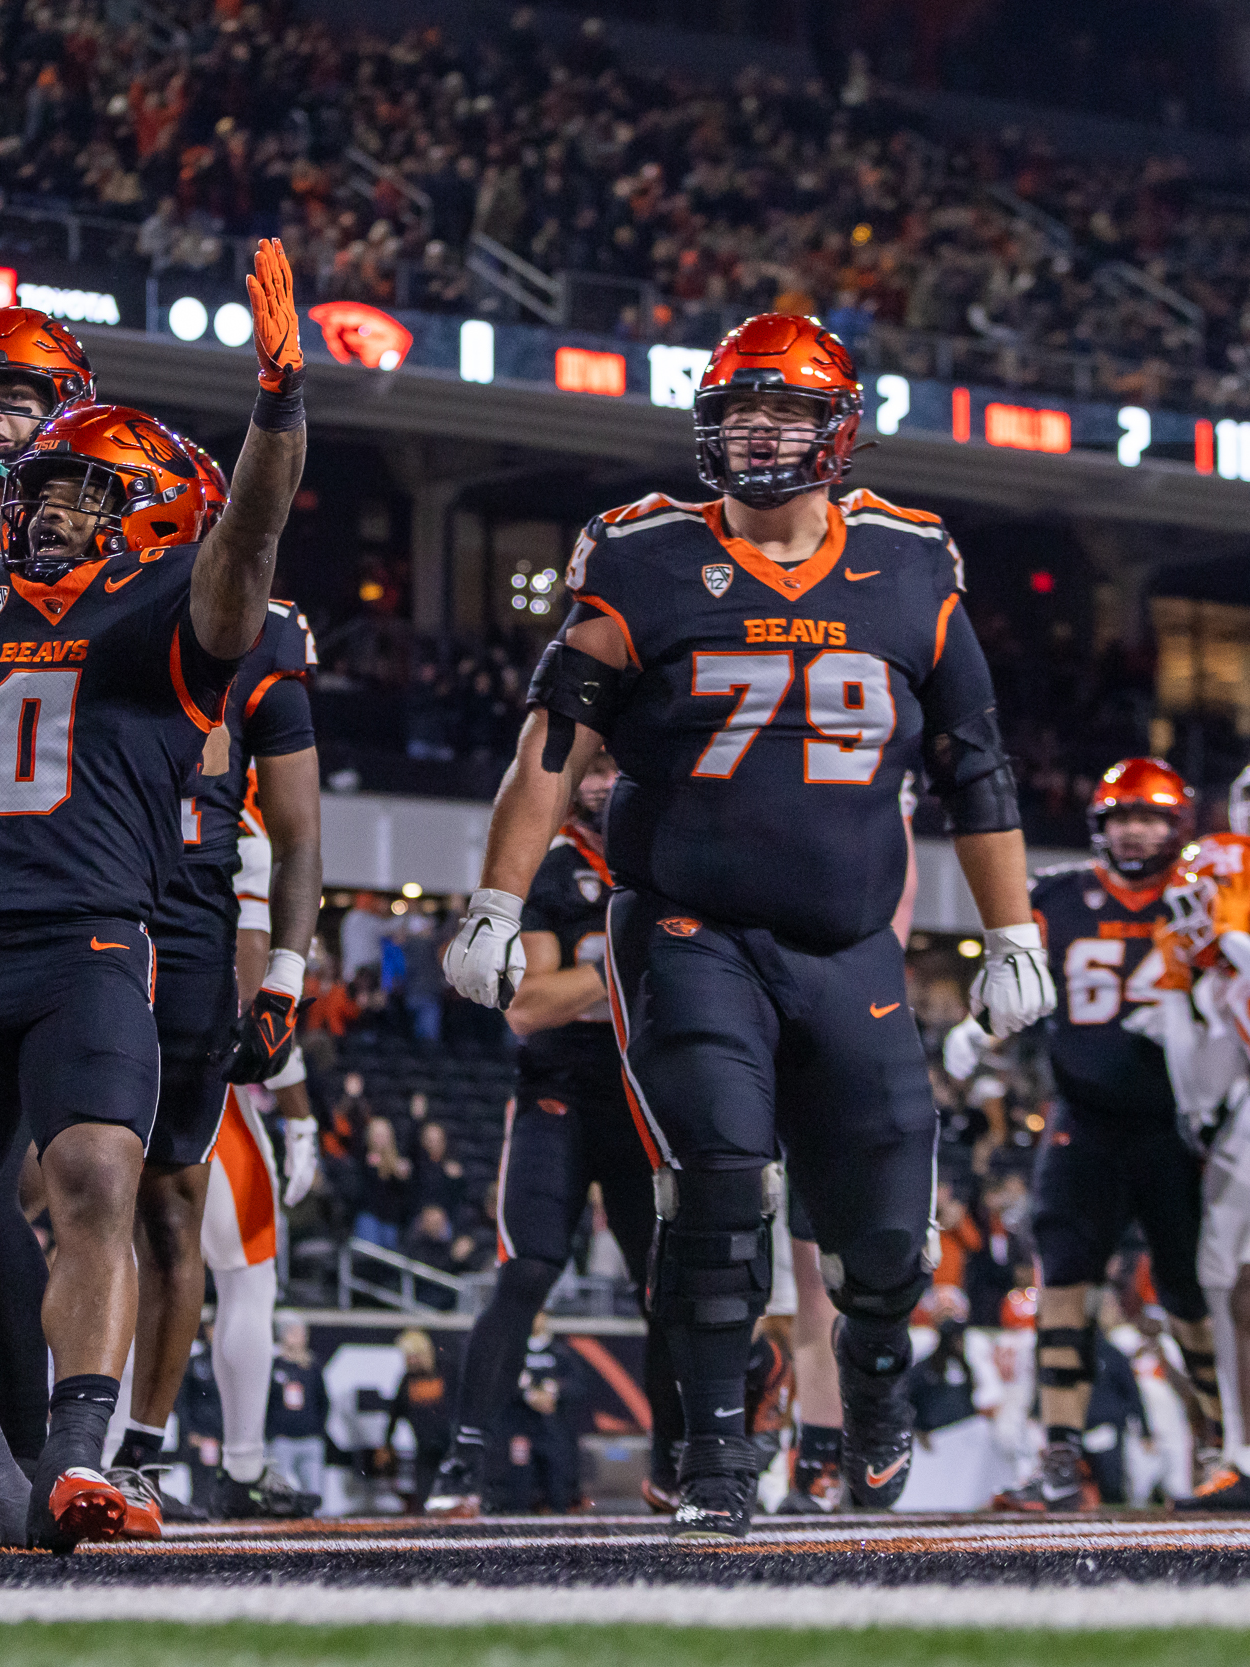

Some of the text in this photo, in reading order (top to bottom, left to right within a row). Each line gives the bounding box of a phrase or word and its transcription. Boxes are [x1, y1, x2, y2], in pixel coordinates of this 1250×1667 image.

[34, 439, 61, 451] OSU
[743, 617, 848, 647] BEAVS
[690, 649, 897, 786] 79
